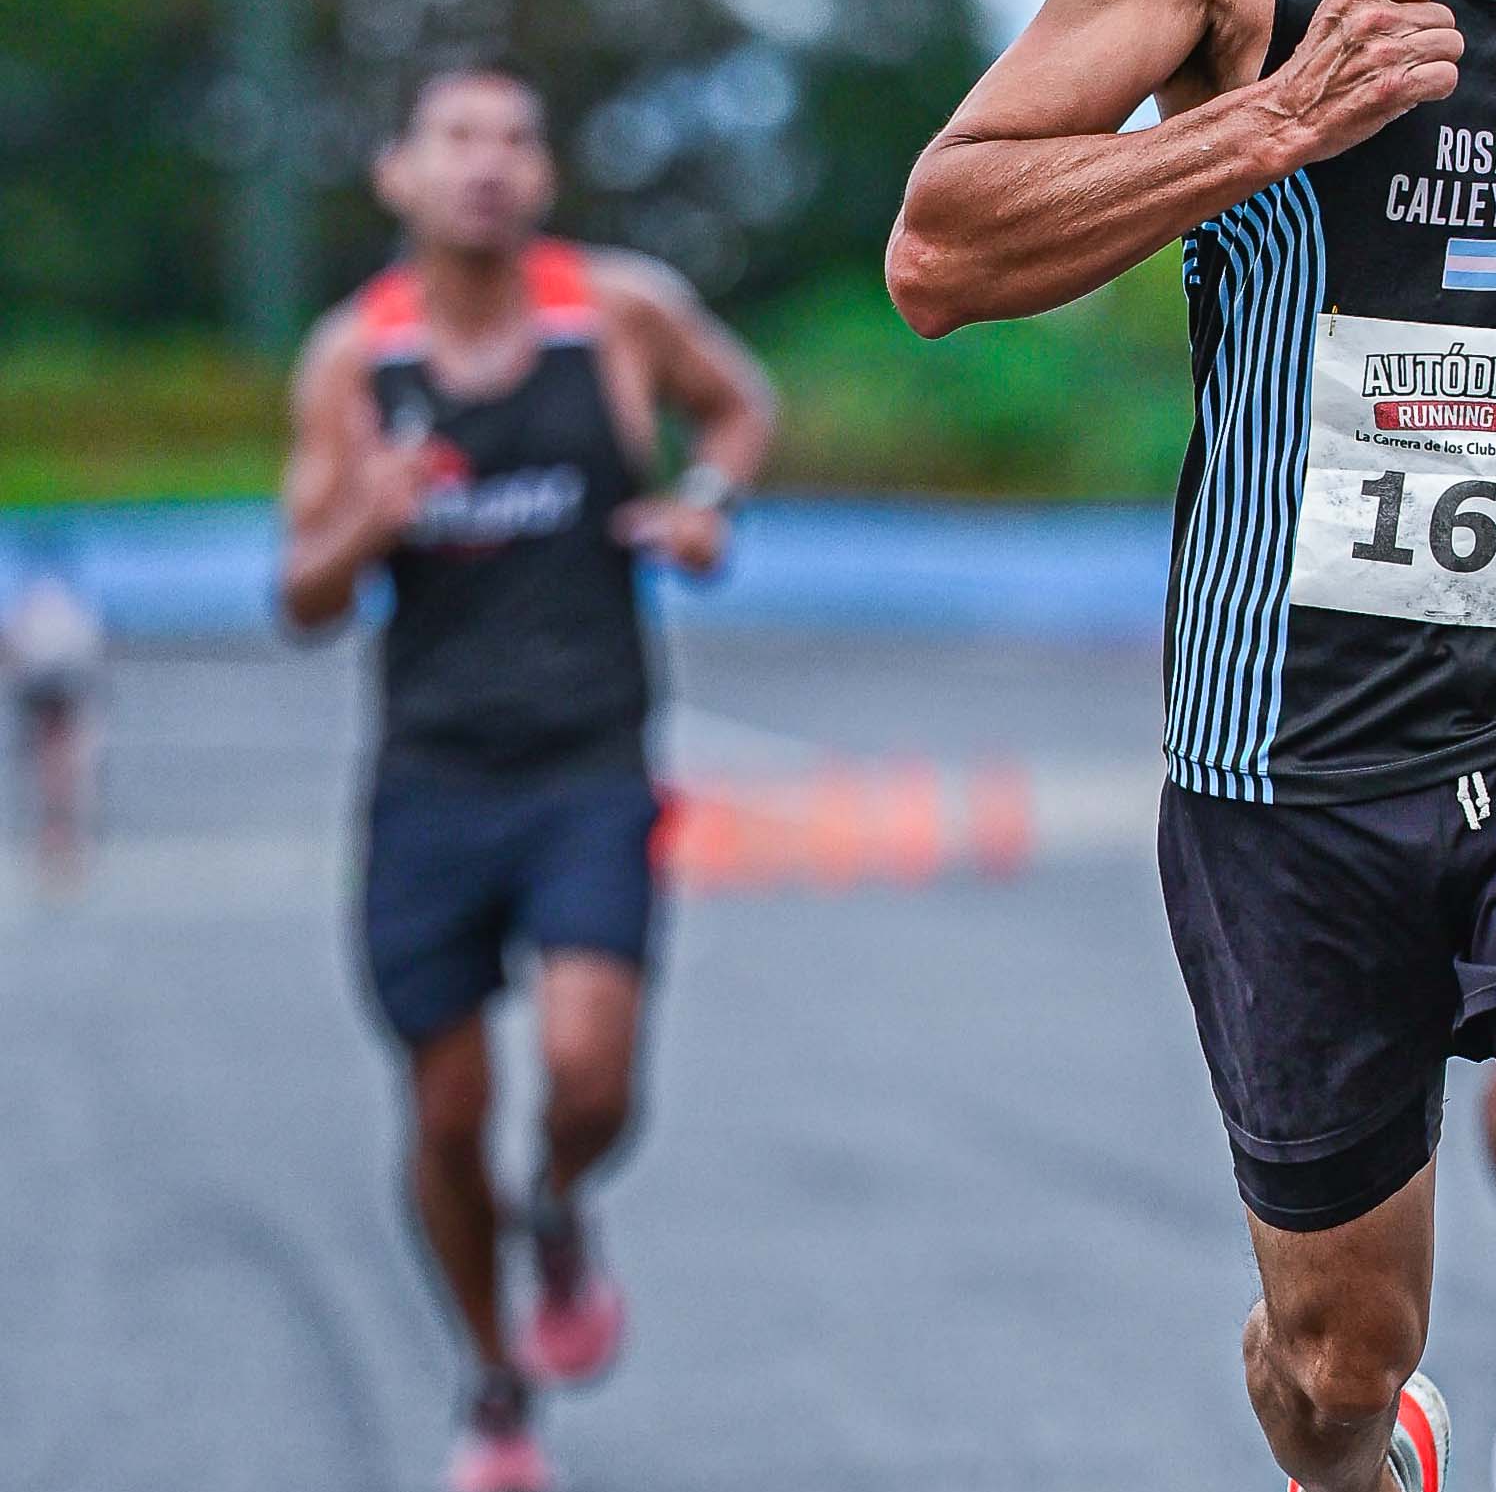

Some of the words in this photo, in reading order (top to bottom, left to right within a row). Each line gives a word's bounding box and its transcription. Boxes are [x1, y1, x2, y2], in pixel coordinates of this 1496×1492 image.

[1398, 405, 1494, 429] RUNNING
[1355, 429, 1370, 442] La
[1373, 433, 1421, 450] Carrera
[1424, 439, 1441, 452] de
[1443, 440, 1463, 454] los
